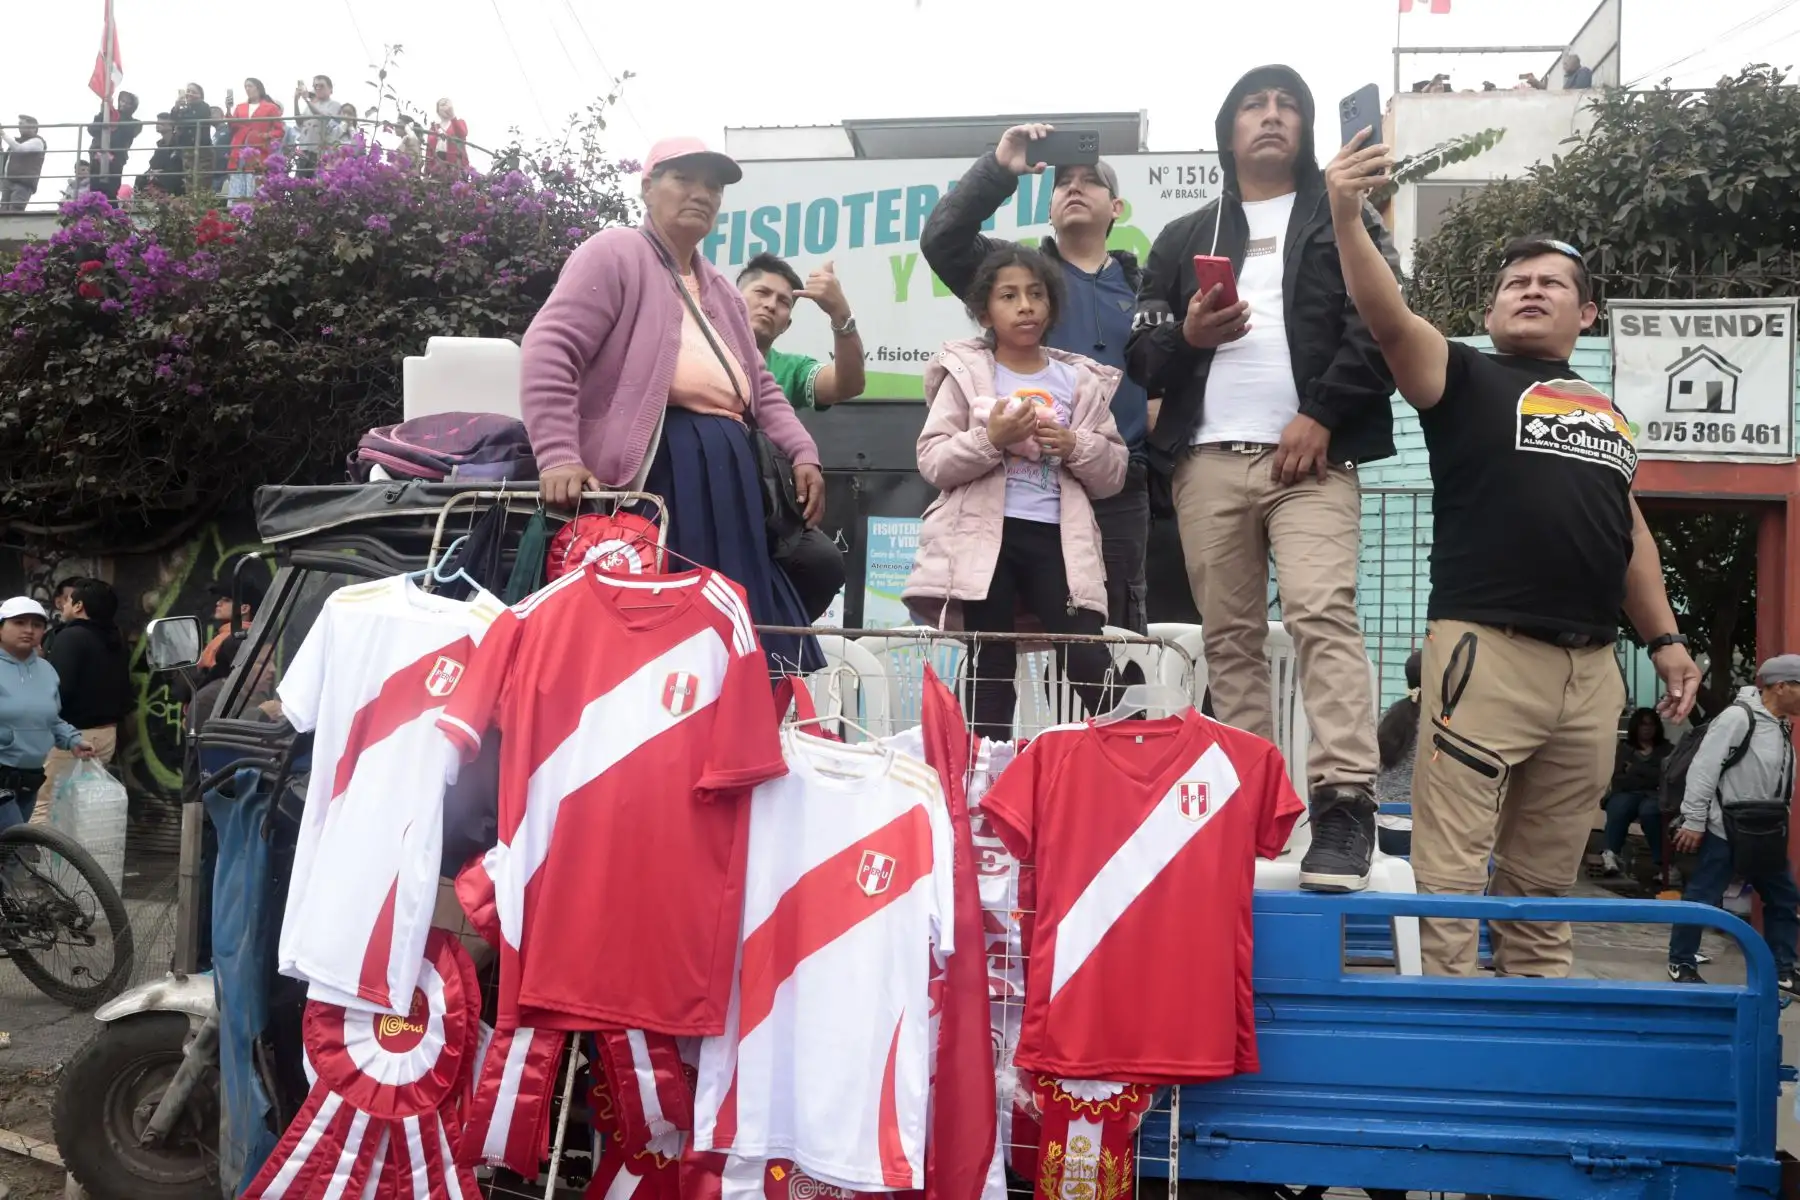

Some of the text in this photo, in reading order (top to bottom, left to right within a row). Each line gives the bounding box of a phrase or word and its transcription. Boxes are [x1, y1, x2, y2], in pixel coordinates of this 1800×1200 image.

[1176, 165, 1219, 185] 1516
[1160, 188, 1207, 199] AV BRASIL
[889, 252, 919, 303] Y
[1620, 313, 1785, 338] SE VENDE
[1523, 437, 1560, 449] ALWAYS
[1647, 421, 1781, 445] 975 386 461
[1550, 423, 1636, 468] Columbia
[862, 864, 889, 879] PERU
